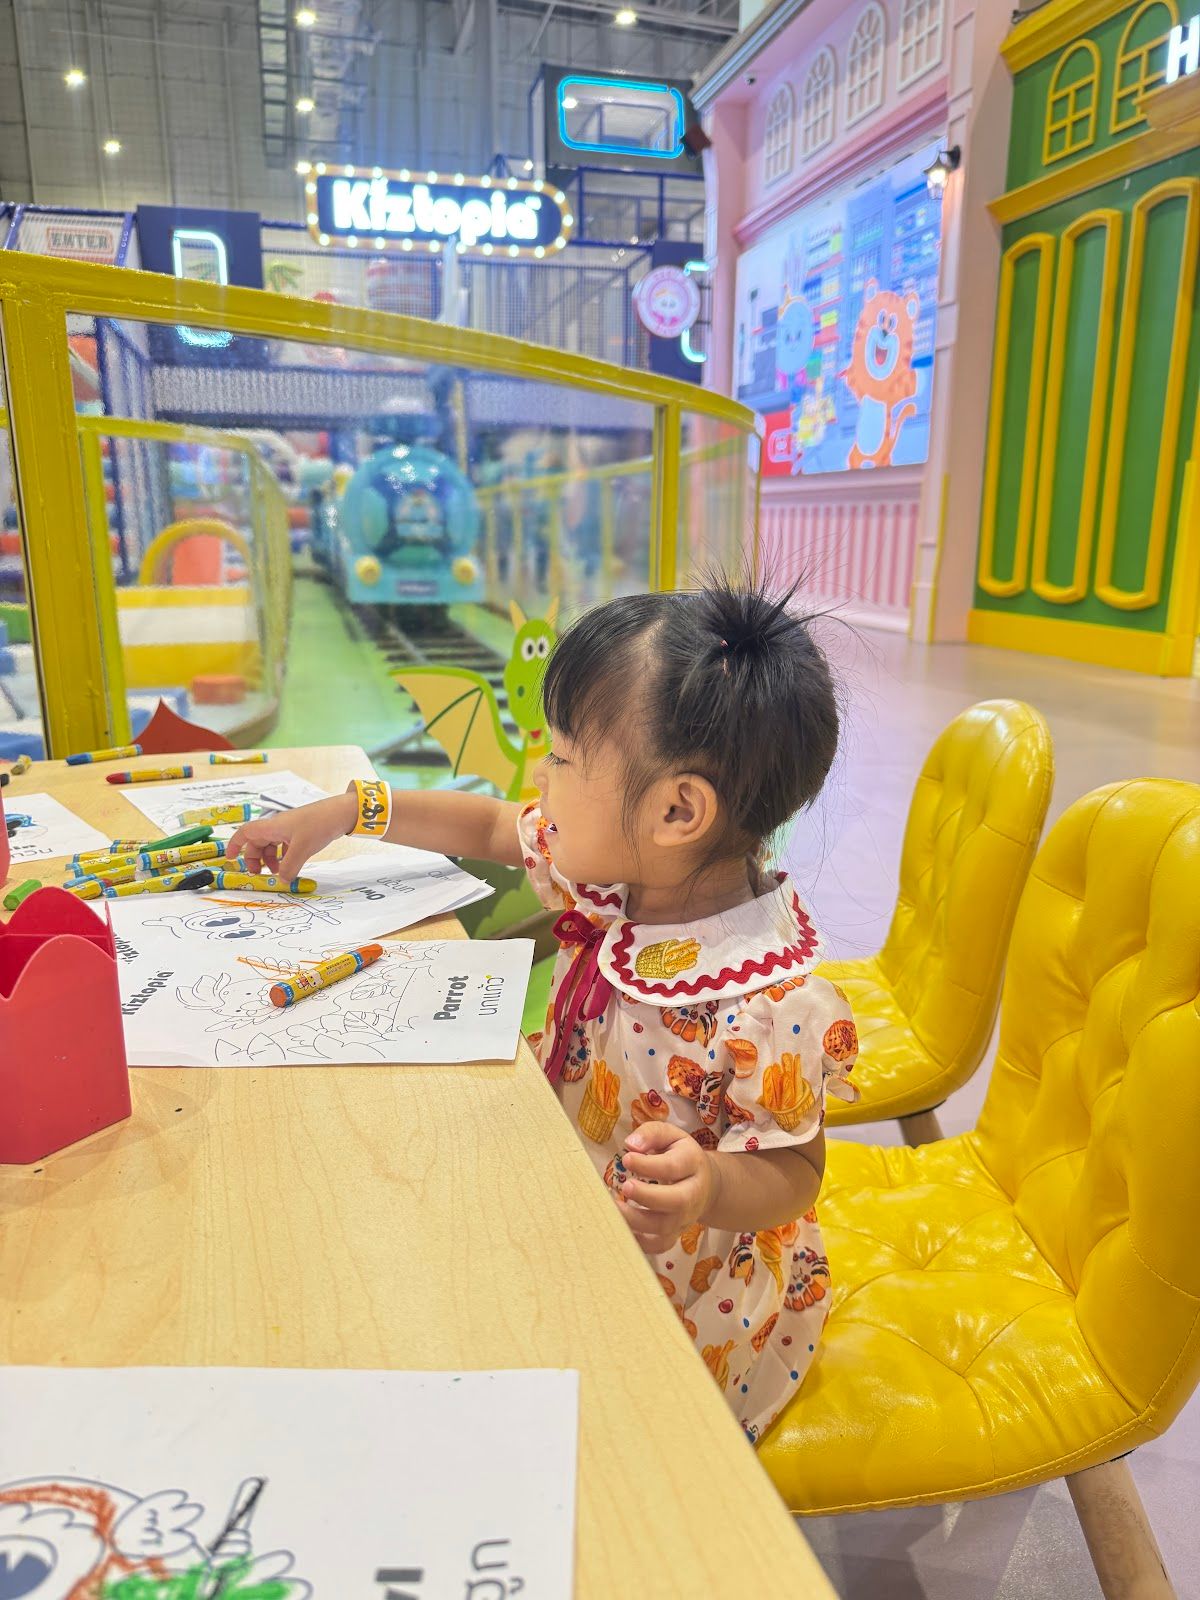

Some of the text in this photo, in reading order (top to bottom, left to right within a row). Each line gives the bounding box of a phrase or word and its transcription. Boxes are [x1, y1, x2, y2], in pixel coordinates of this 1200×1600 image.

[332, 176, 540, 246] Kiztopia
[51, 232, 107, 249] ENTER
[432, 975, 469, 1020] Parrot
[477, 977, 505, 1016] นกแก้ว
